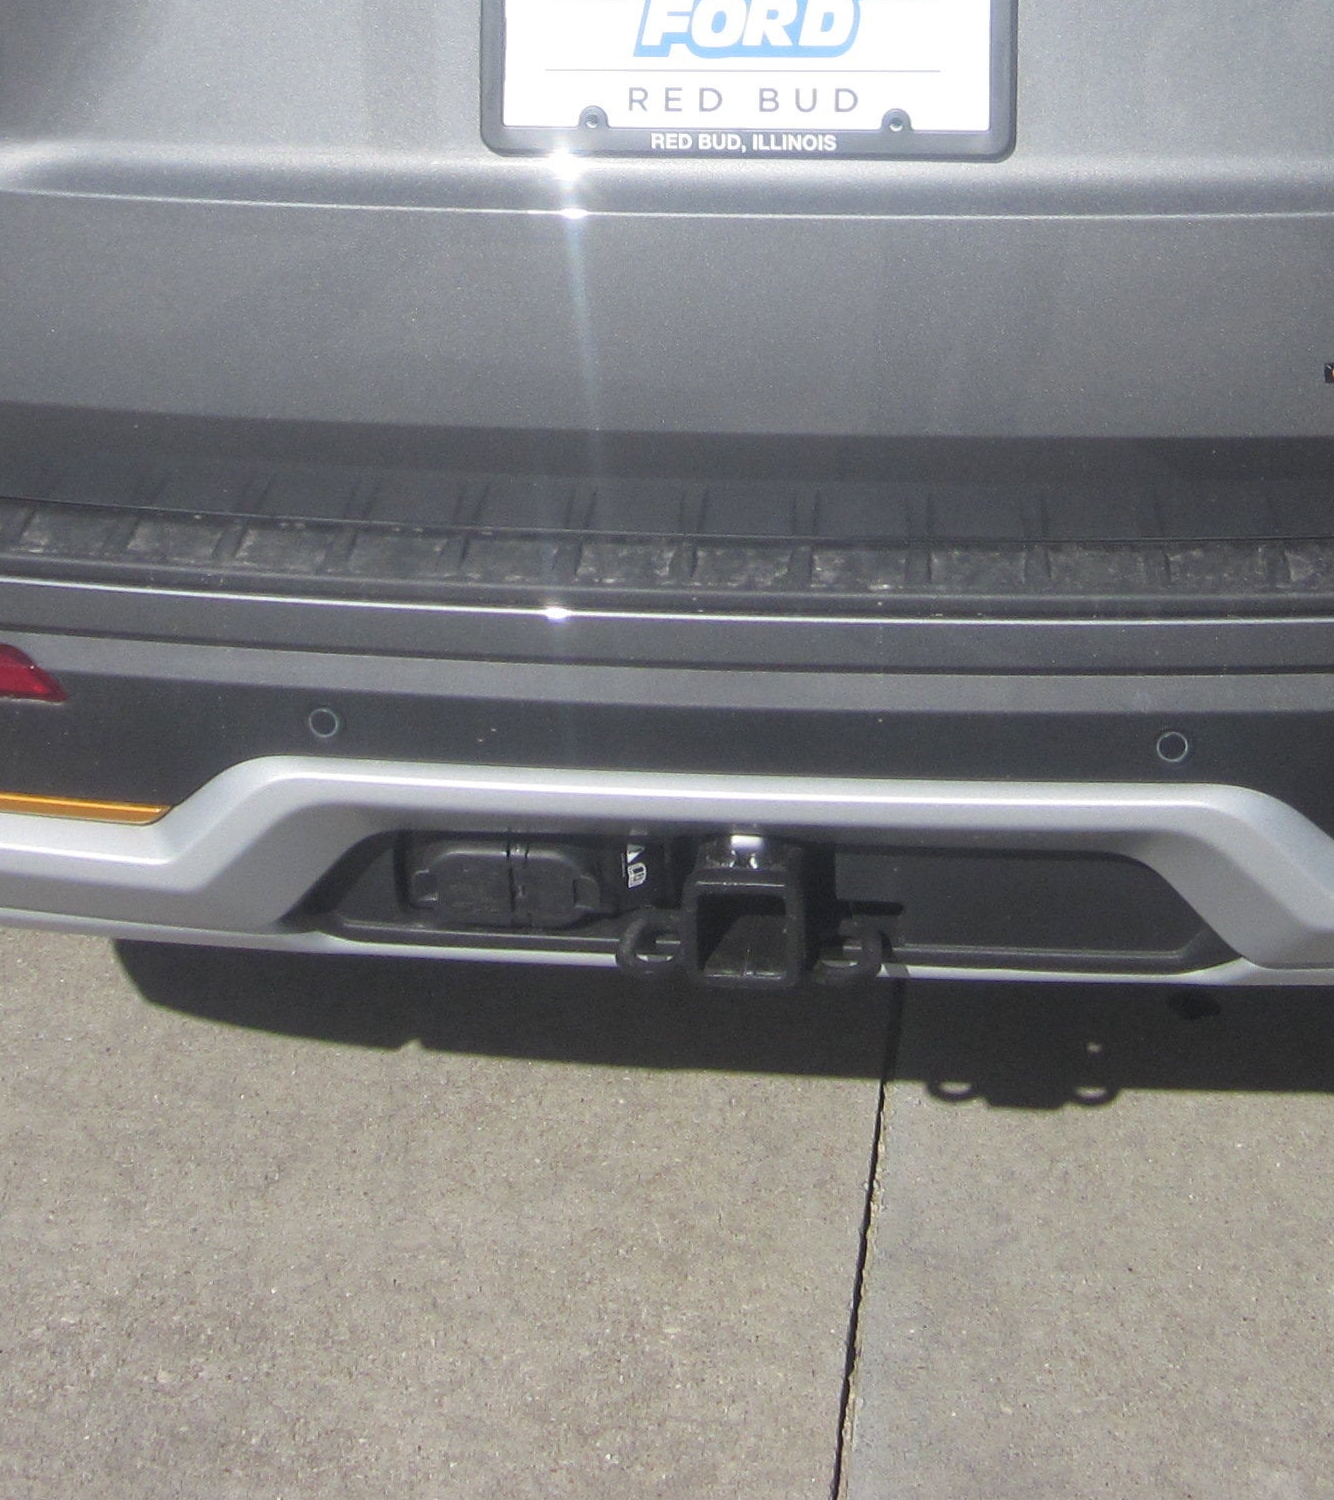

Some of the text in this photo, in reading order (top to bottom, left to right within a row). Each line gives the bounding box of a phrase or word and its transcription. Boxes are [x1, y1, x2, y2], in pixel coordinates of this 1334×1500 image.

[628, 87, 859, 113] RED BUD
[650, 132, 838, 153] RED BUD, ILLINOIS
